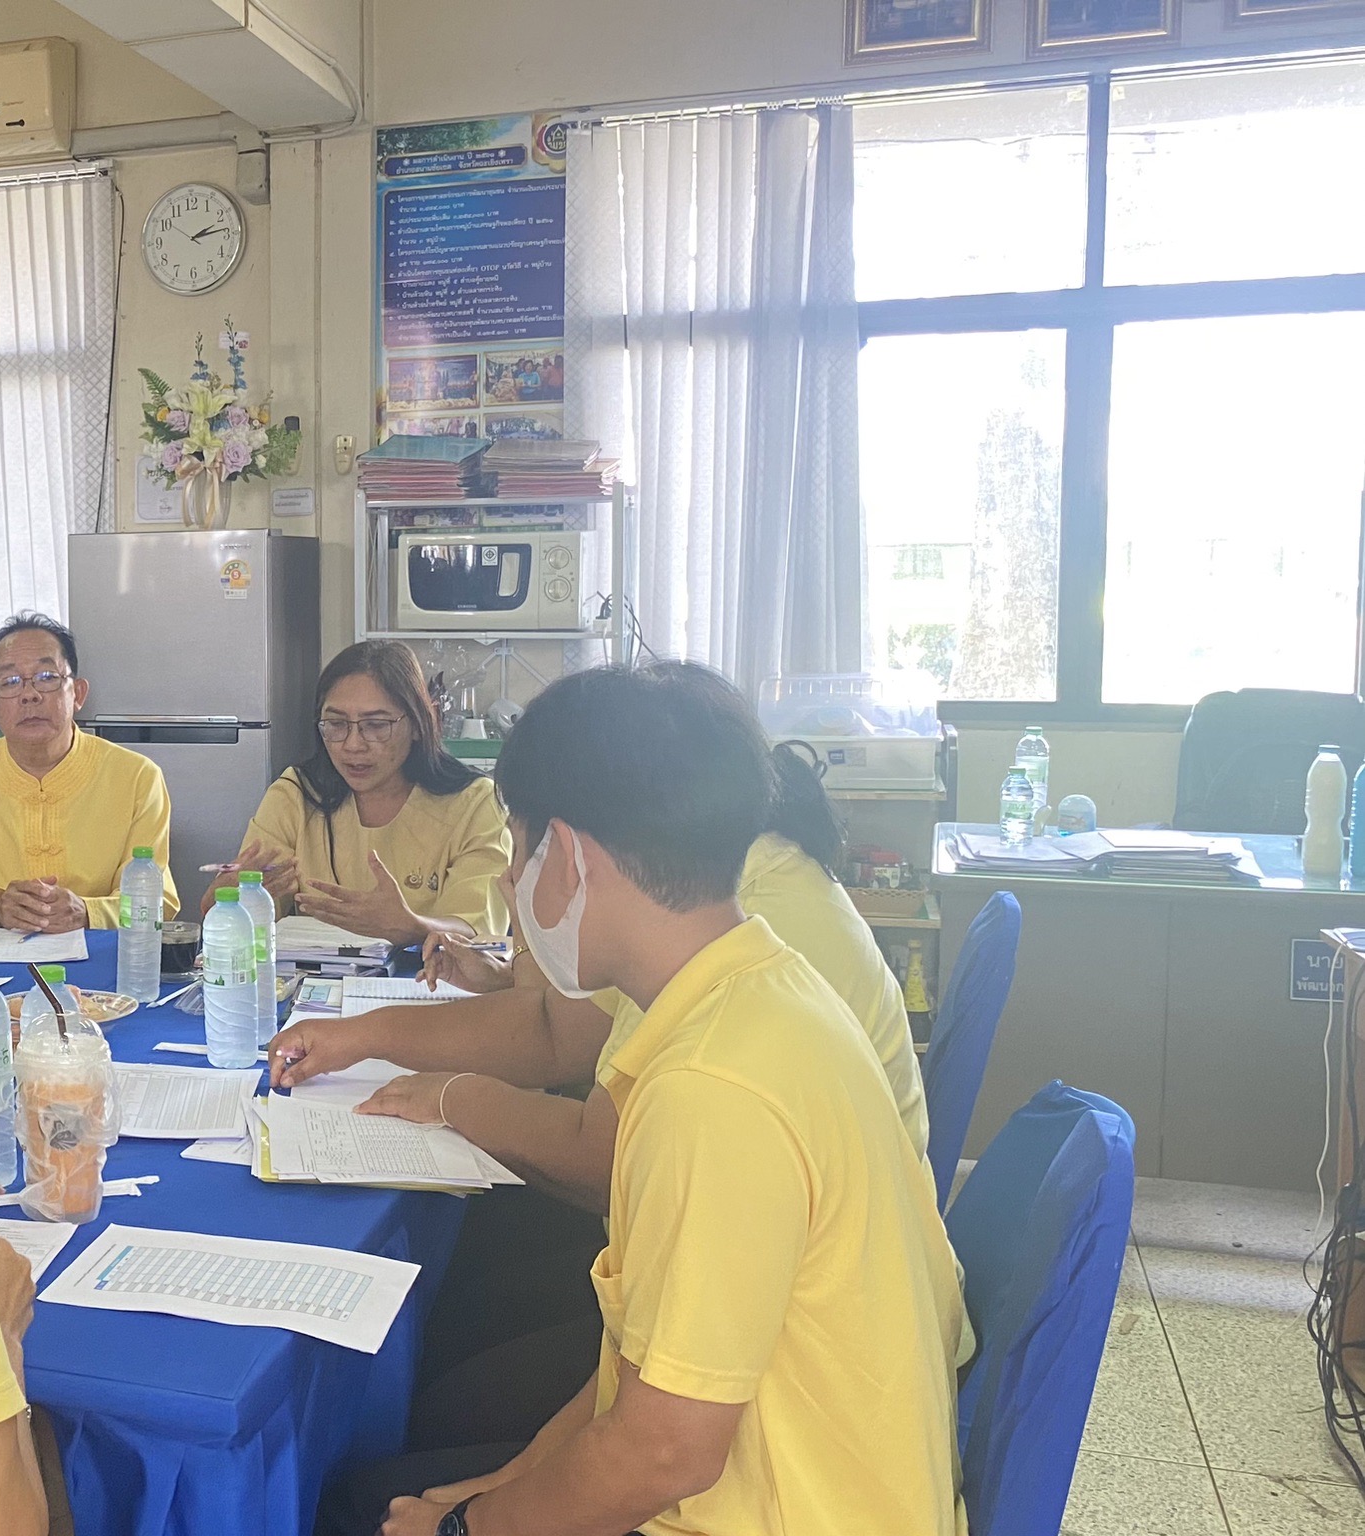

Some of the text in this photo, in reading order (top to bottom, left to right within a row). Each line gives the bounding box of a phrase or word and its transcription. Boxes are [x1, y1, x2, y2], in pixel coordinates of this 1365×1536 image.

[185, 197, 198, 211] 12
[205, 199, 209, 212] 1
[172, 204, 181, 218] 11
[217, 209, 224, 222] 2
[160, 218, 172, 232] 10
[223, 227, 230, 240] 3
[156, 237, 163, 250] 9
[217, 245, 224, 258] 4
[161, 253, 168, 267] 8
[206, 260, 214, 273] 5
[173, 264, 180, 278] 7
[190, 267, 197, 280] 6
[480, 264, 500, 272] OTOP
